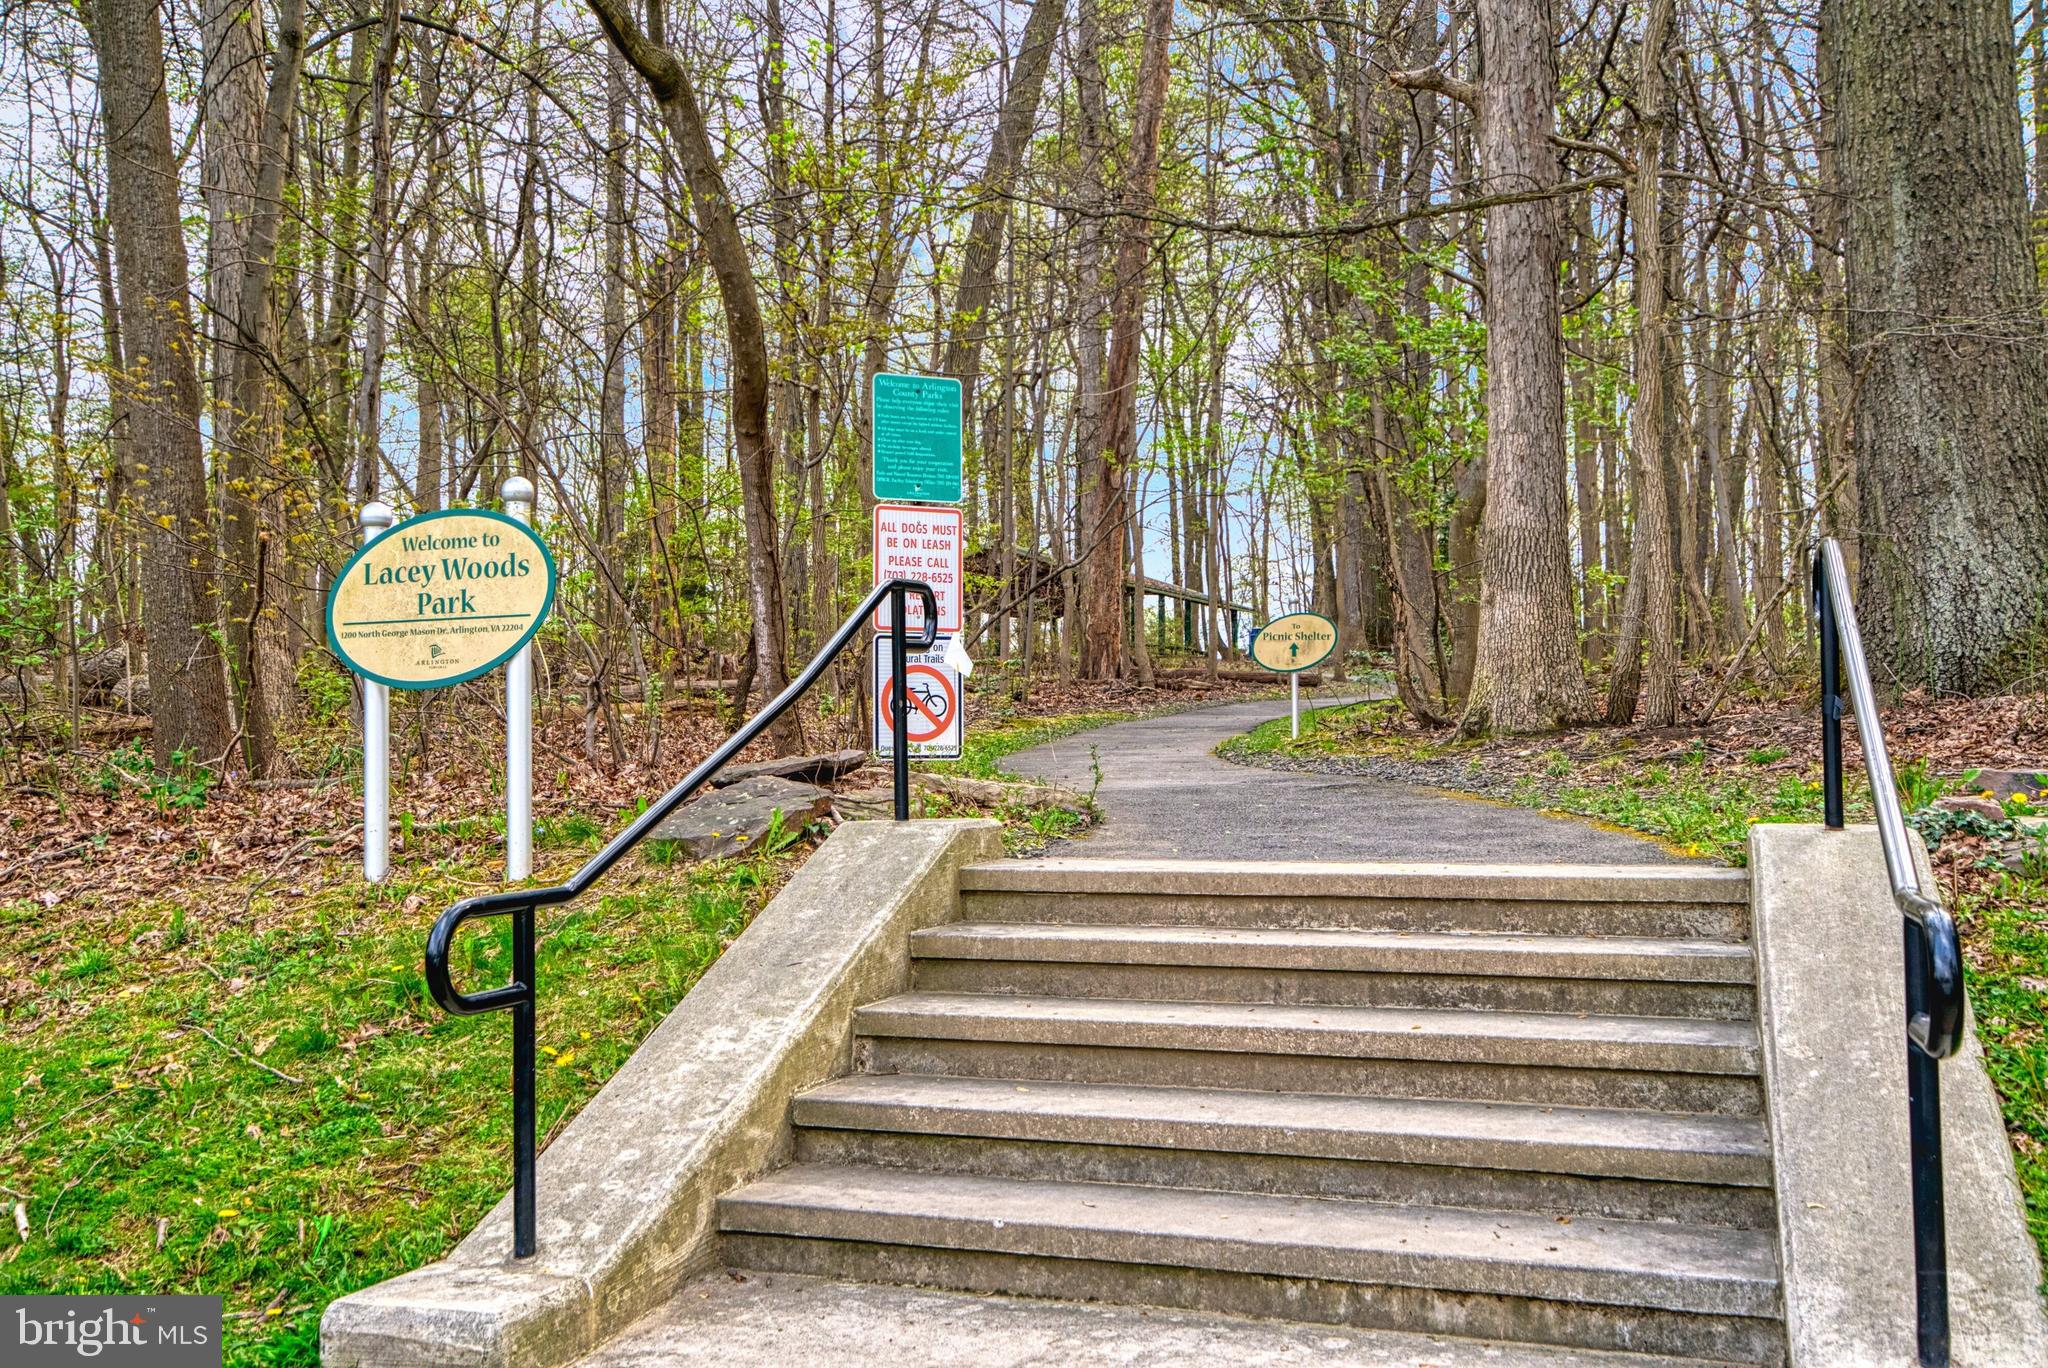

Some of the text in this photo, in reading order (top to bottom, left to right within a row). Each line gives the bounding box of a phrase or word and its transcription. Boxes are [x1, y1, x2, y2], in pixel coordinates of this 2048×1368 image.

[878, 379, 910, 388] Welcome
[922, 382, 956, 392] Arlington
[892, 388, 942, 400] County Parks
[880, 522, 957, 536] ALL DOGS MUST
[402, 532, 500, 552] Welcome to
[887, 538, 950, 550] BE ON LEASH
[888, 556, 948, 568] PLEASE CALL
[364, 552, 530, 588] Lacey Woods
[884, 569, 953, 584] (703) 228-6525
[418, 588, 476, 616] Park
[358, 630, 380, 638] North
[382, 630, 409, 638] George
[410, 628, 436, 636] Mason
[490, 624, 501, 632] VA
[1263, 631, 1332, 640] Picnic Shelter
[924, 654, 944, 664] Trails
